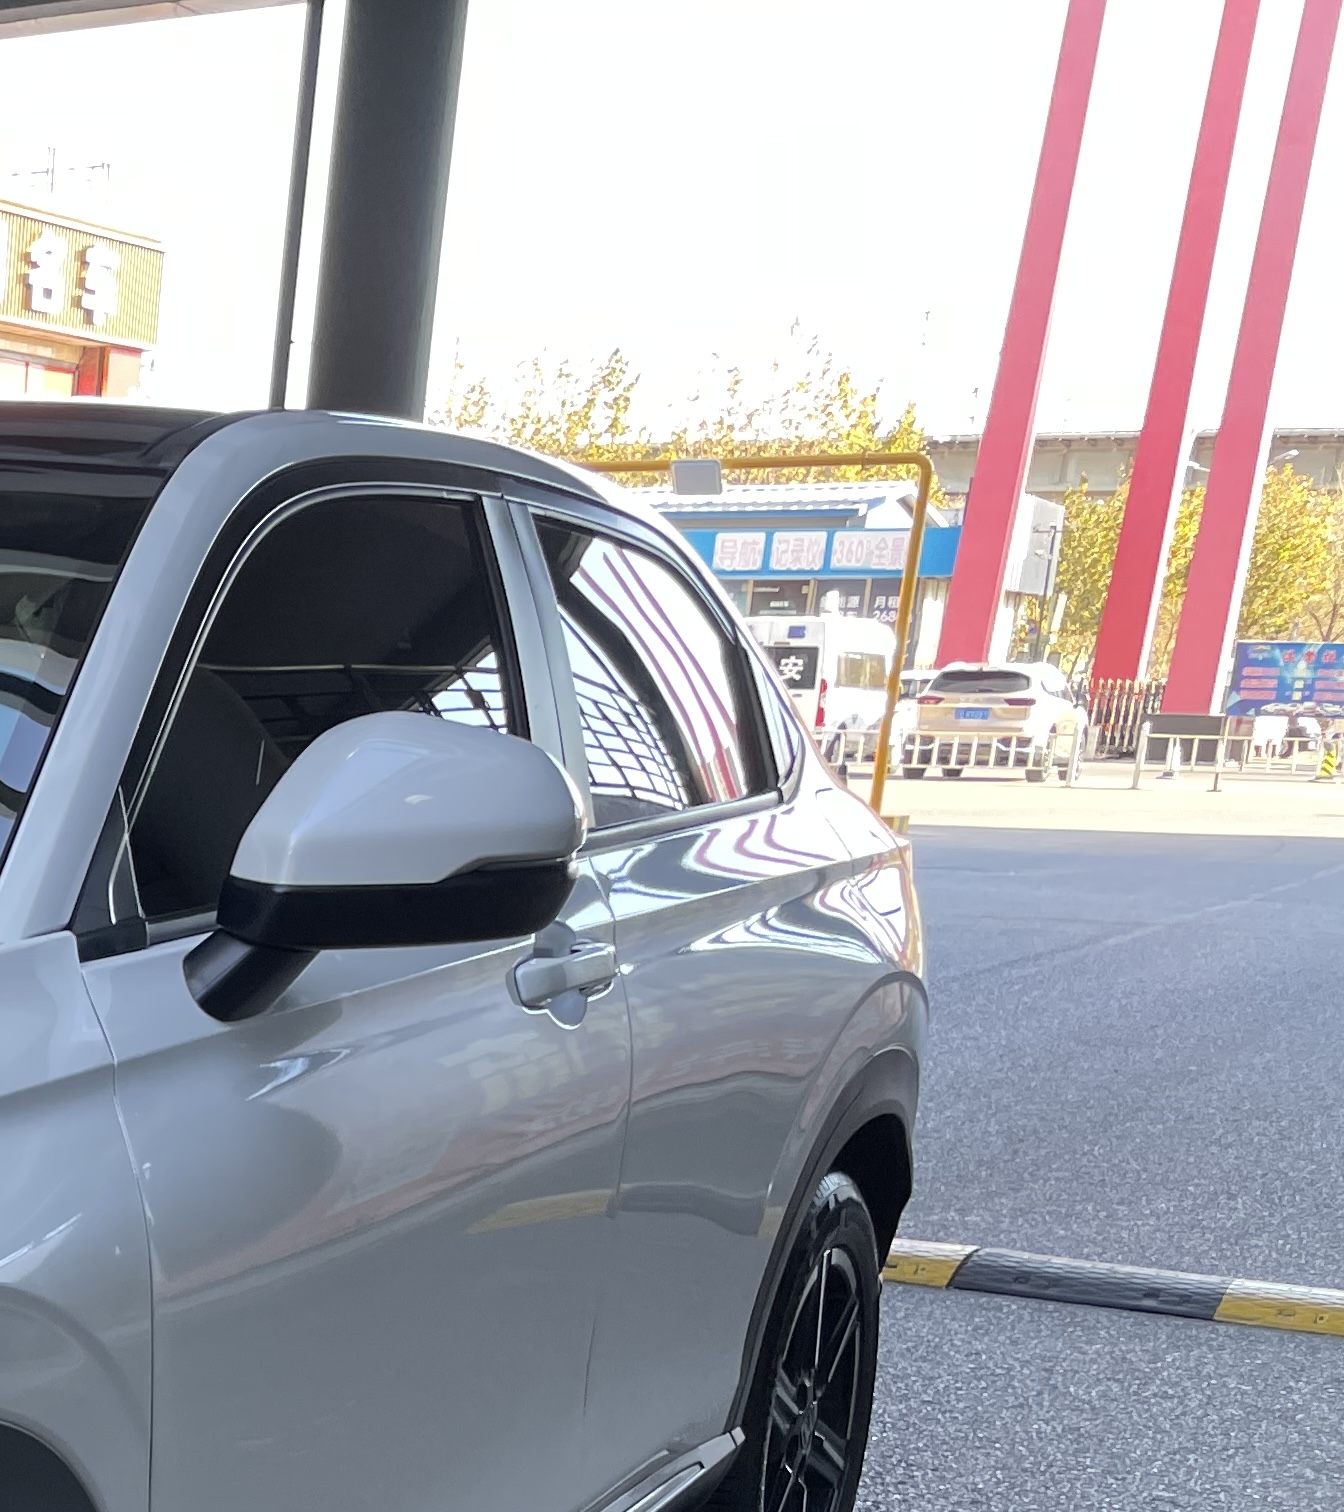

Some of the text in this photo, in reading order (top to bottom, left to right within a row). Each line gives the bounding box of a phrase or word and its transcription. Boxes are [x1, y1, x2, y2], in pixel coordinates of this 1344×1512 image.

[718, 538, 761, 569] 导航
[775, 537, 822, 569] 记录仪
[779, 655, 804, 681] 安
